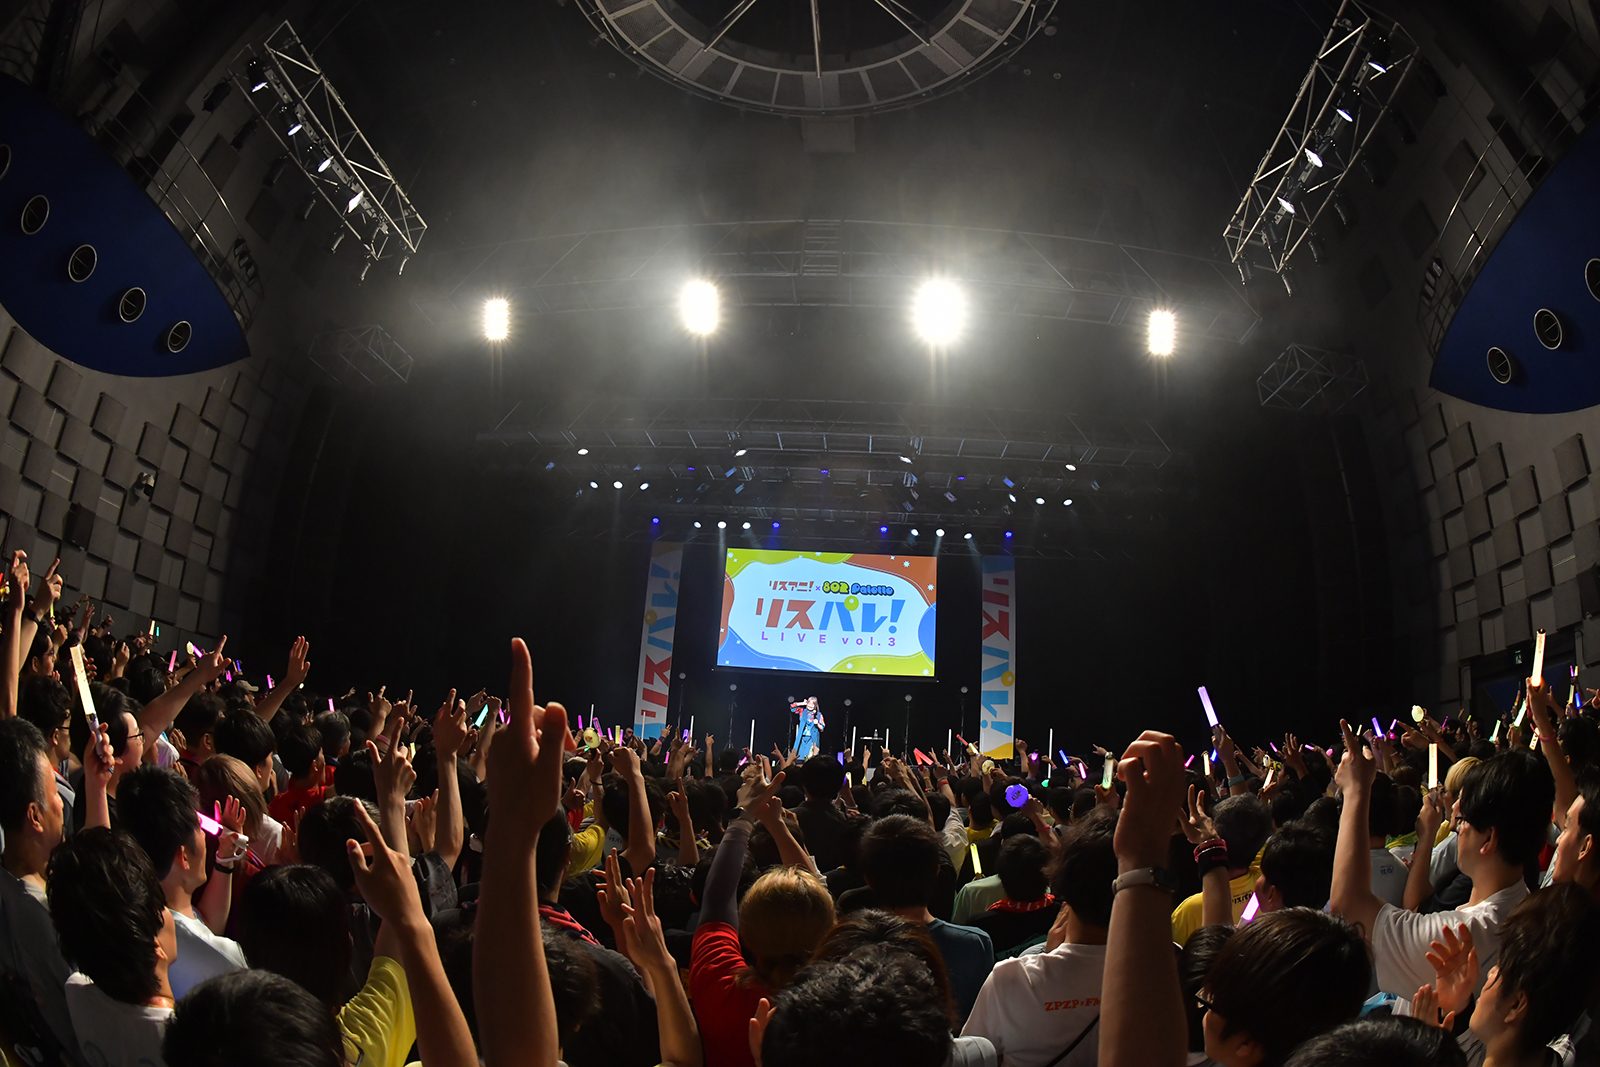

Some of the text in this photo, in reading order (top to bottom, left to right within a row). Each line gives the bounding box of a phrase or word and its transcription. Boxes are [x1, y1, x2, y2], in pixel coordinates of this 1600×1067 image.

[769, 580, 814, 592] リスアニ!
[851, 583, 895, 596] Palette
[755, 595, 906, 634] リスパレ!
[761, 631, 827, 644] LIVE
